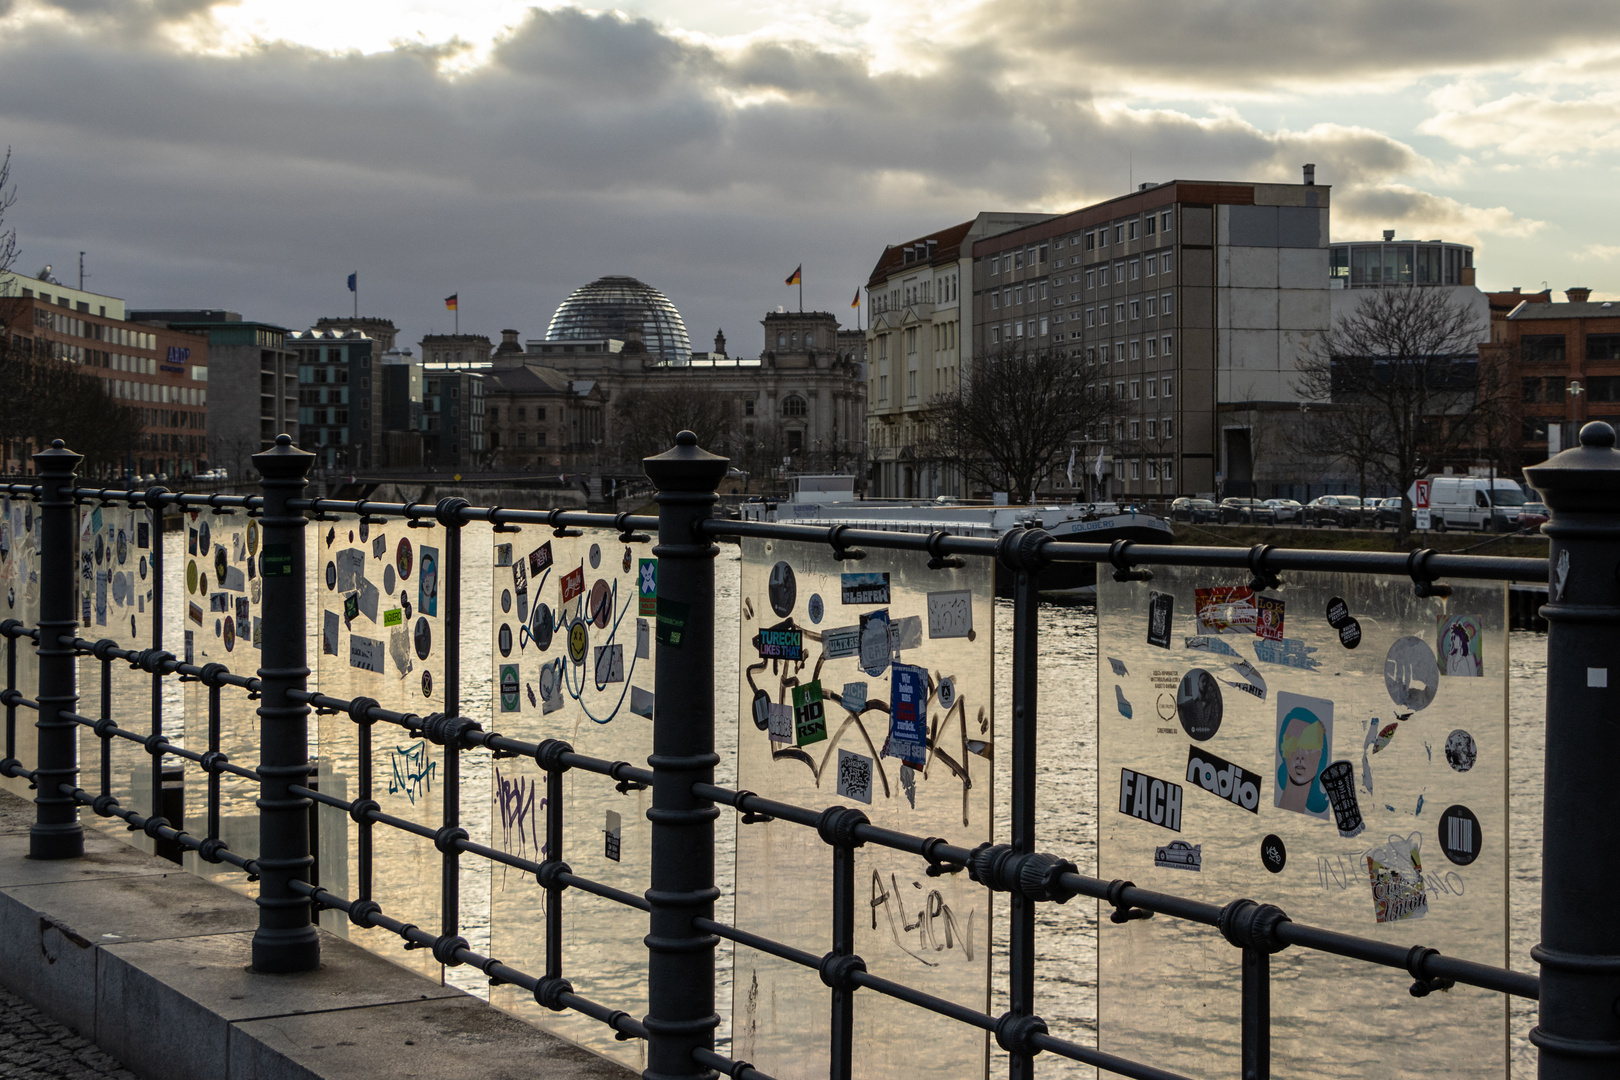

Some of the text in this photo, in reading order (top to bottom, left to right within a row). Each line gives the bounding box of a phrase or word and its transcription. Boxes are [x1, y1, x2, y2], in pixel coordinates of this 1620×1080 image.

[1072, 519, 1114, 533] GOLDBERG
[1259, 600, 1284, 614] LOK
[760, 630, 801, 646] TURECKI
[1256, 626, 1283, 641] HALLE
[760, 645, 801, 657] LIKES THAT
[829, 637, 859, 652] ULTRAS
[796, 701, 823, 724] HD
[798, 722, 824, 739] RSN
[1187, 757, 1258, 810] radio
[1120, 769, 1182, 832] FACH
[1447, 815, 1473, 854] KULTUR
